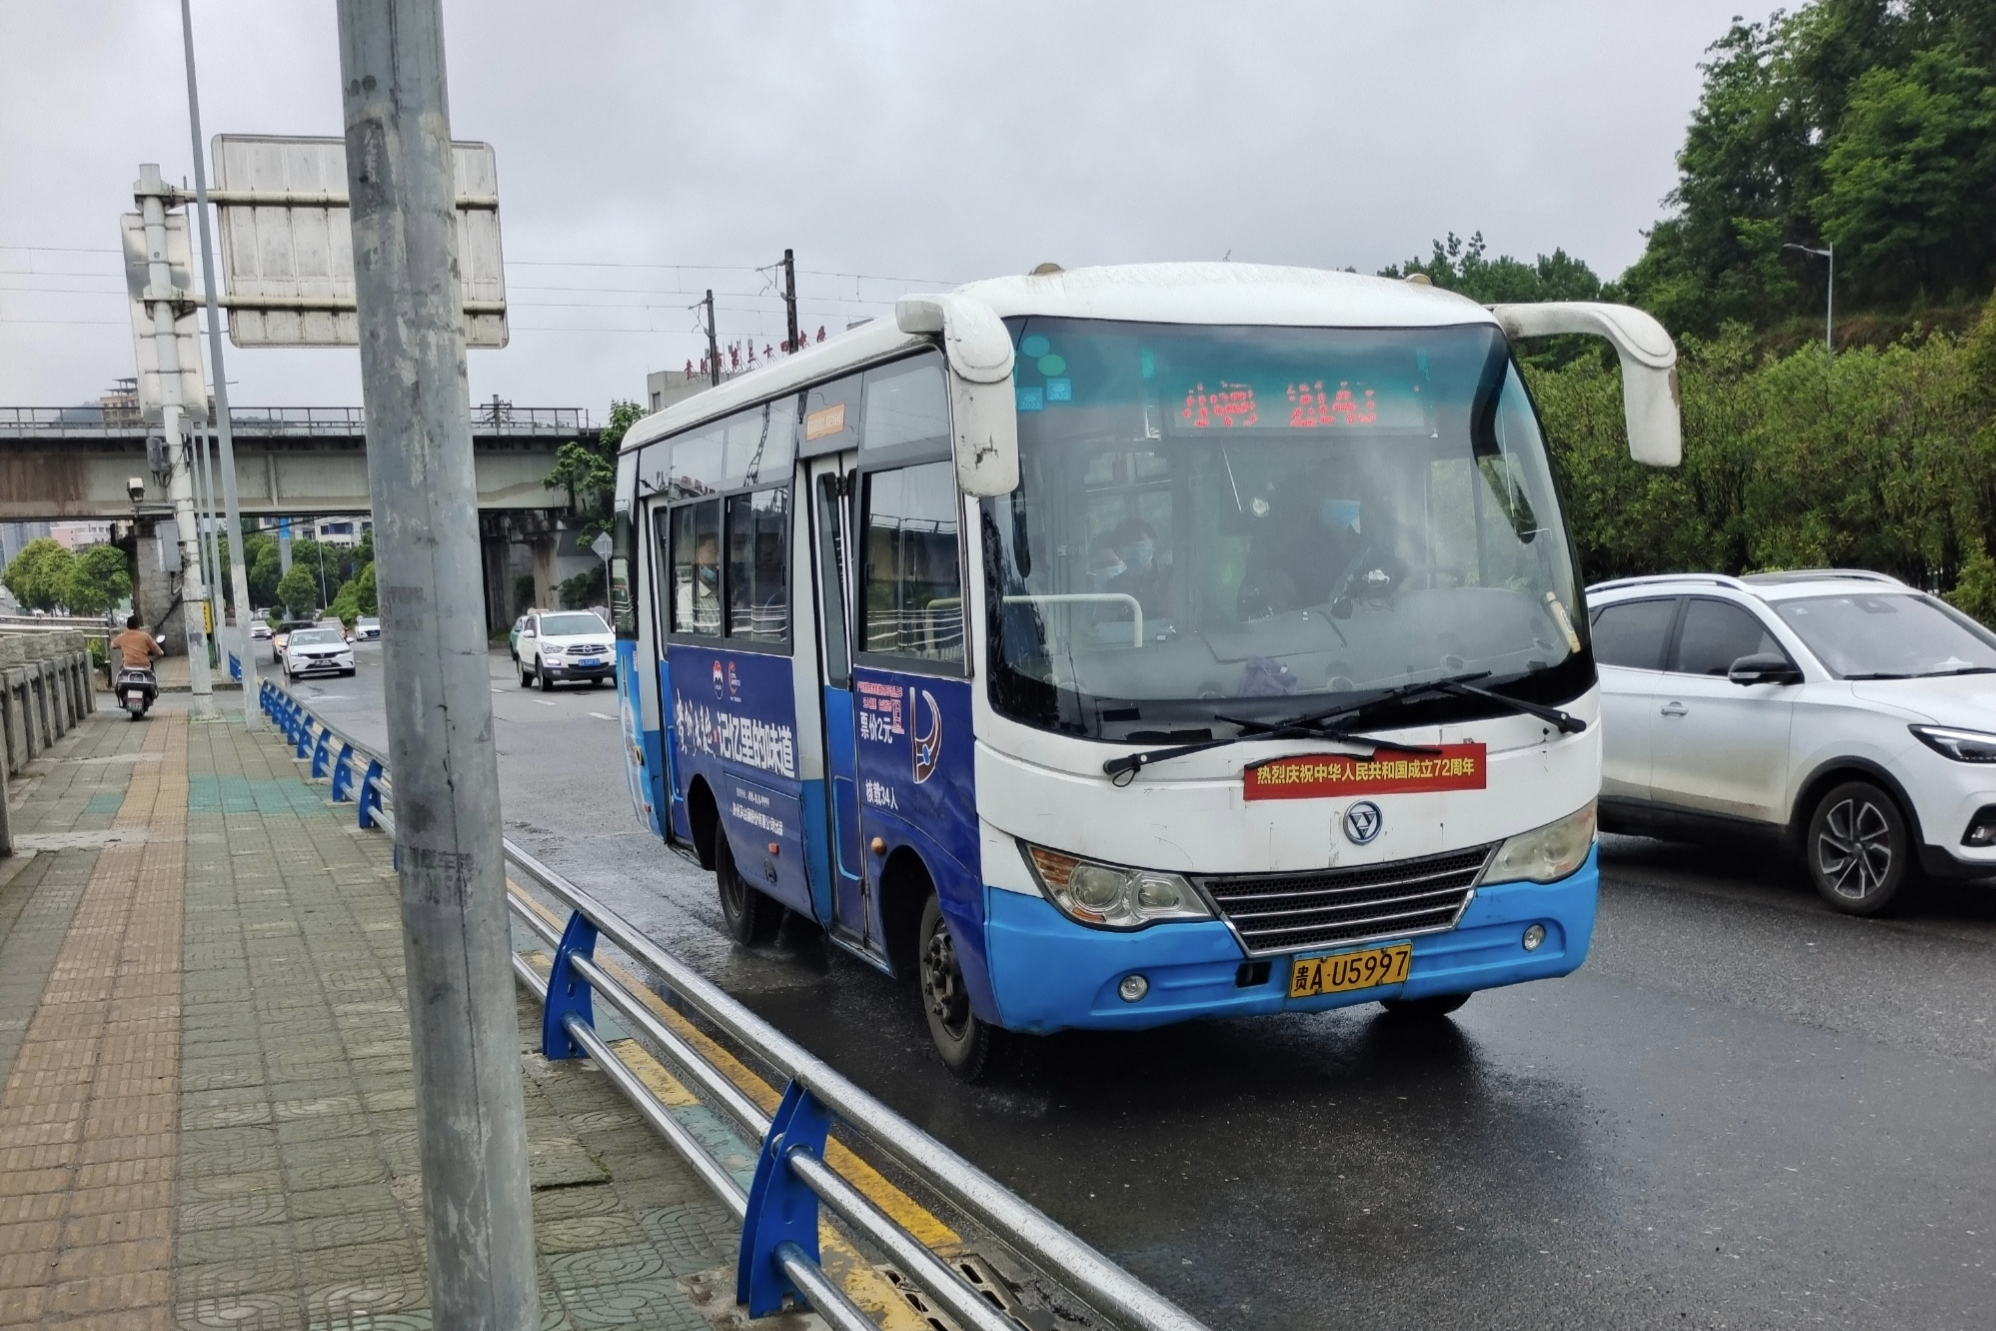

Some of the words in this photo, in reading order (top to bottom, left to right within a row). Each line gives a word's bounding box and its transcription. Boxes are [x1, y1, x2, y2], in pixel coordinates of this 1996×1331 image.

[859, 711, 893, 744] 票价2元
[717, 711, 795, 779] 记忆里的味道
[1256, 757, 1475, 785] 热烈庆祝中华人民共和国成立72周年
[865, 778, 899, 811] 核载34人
